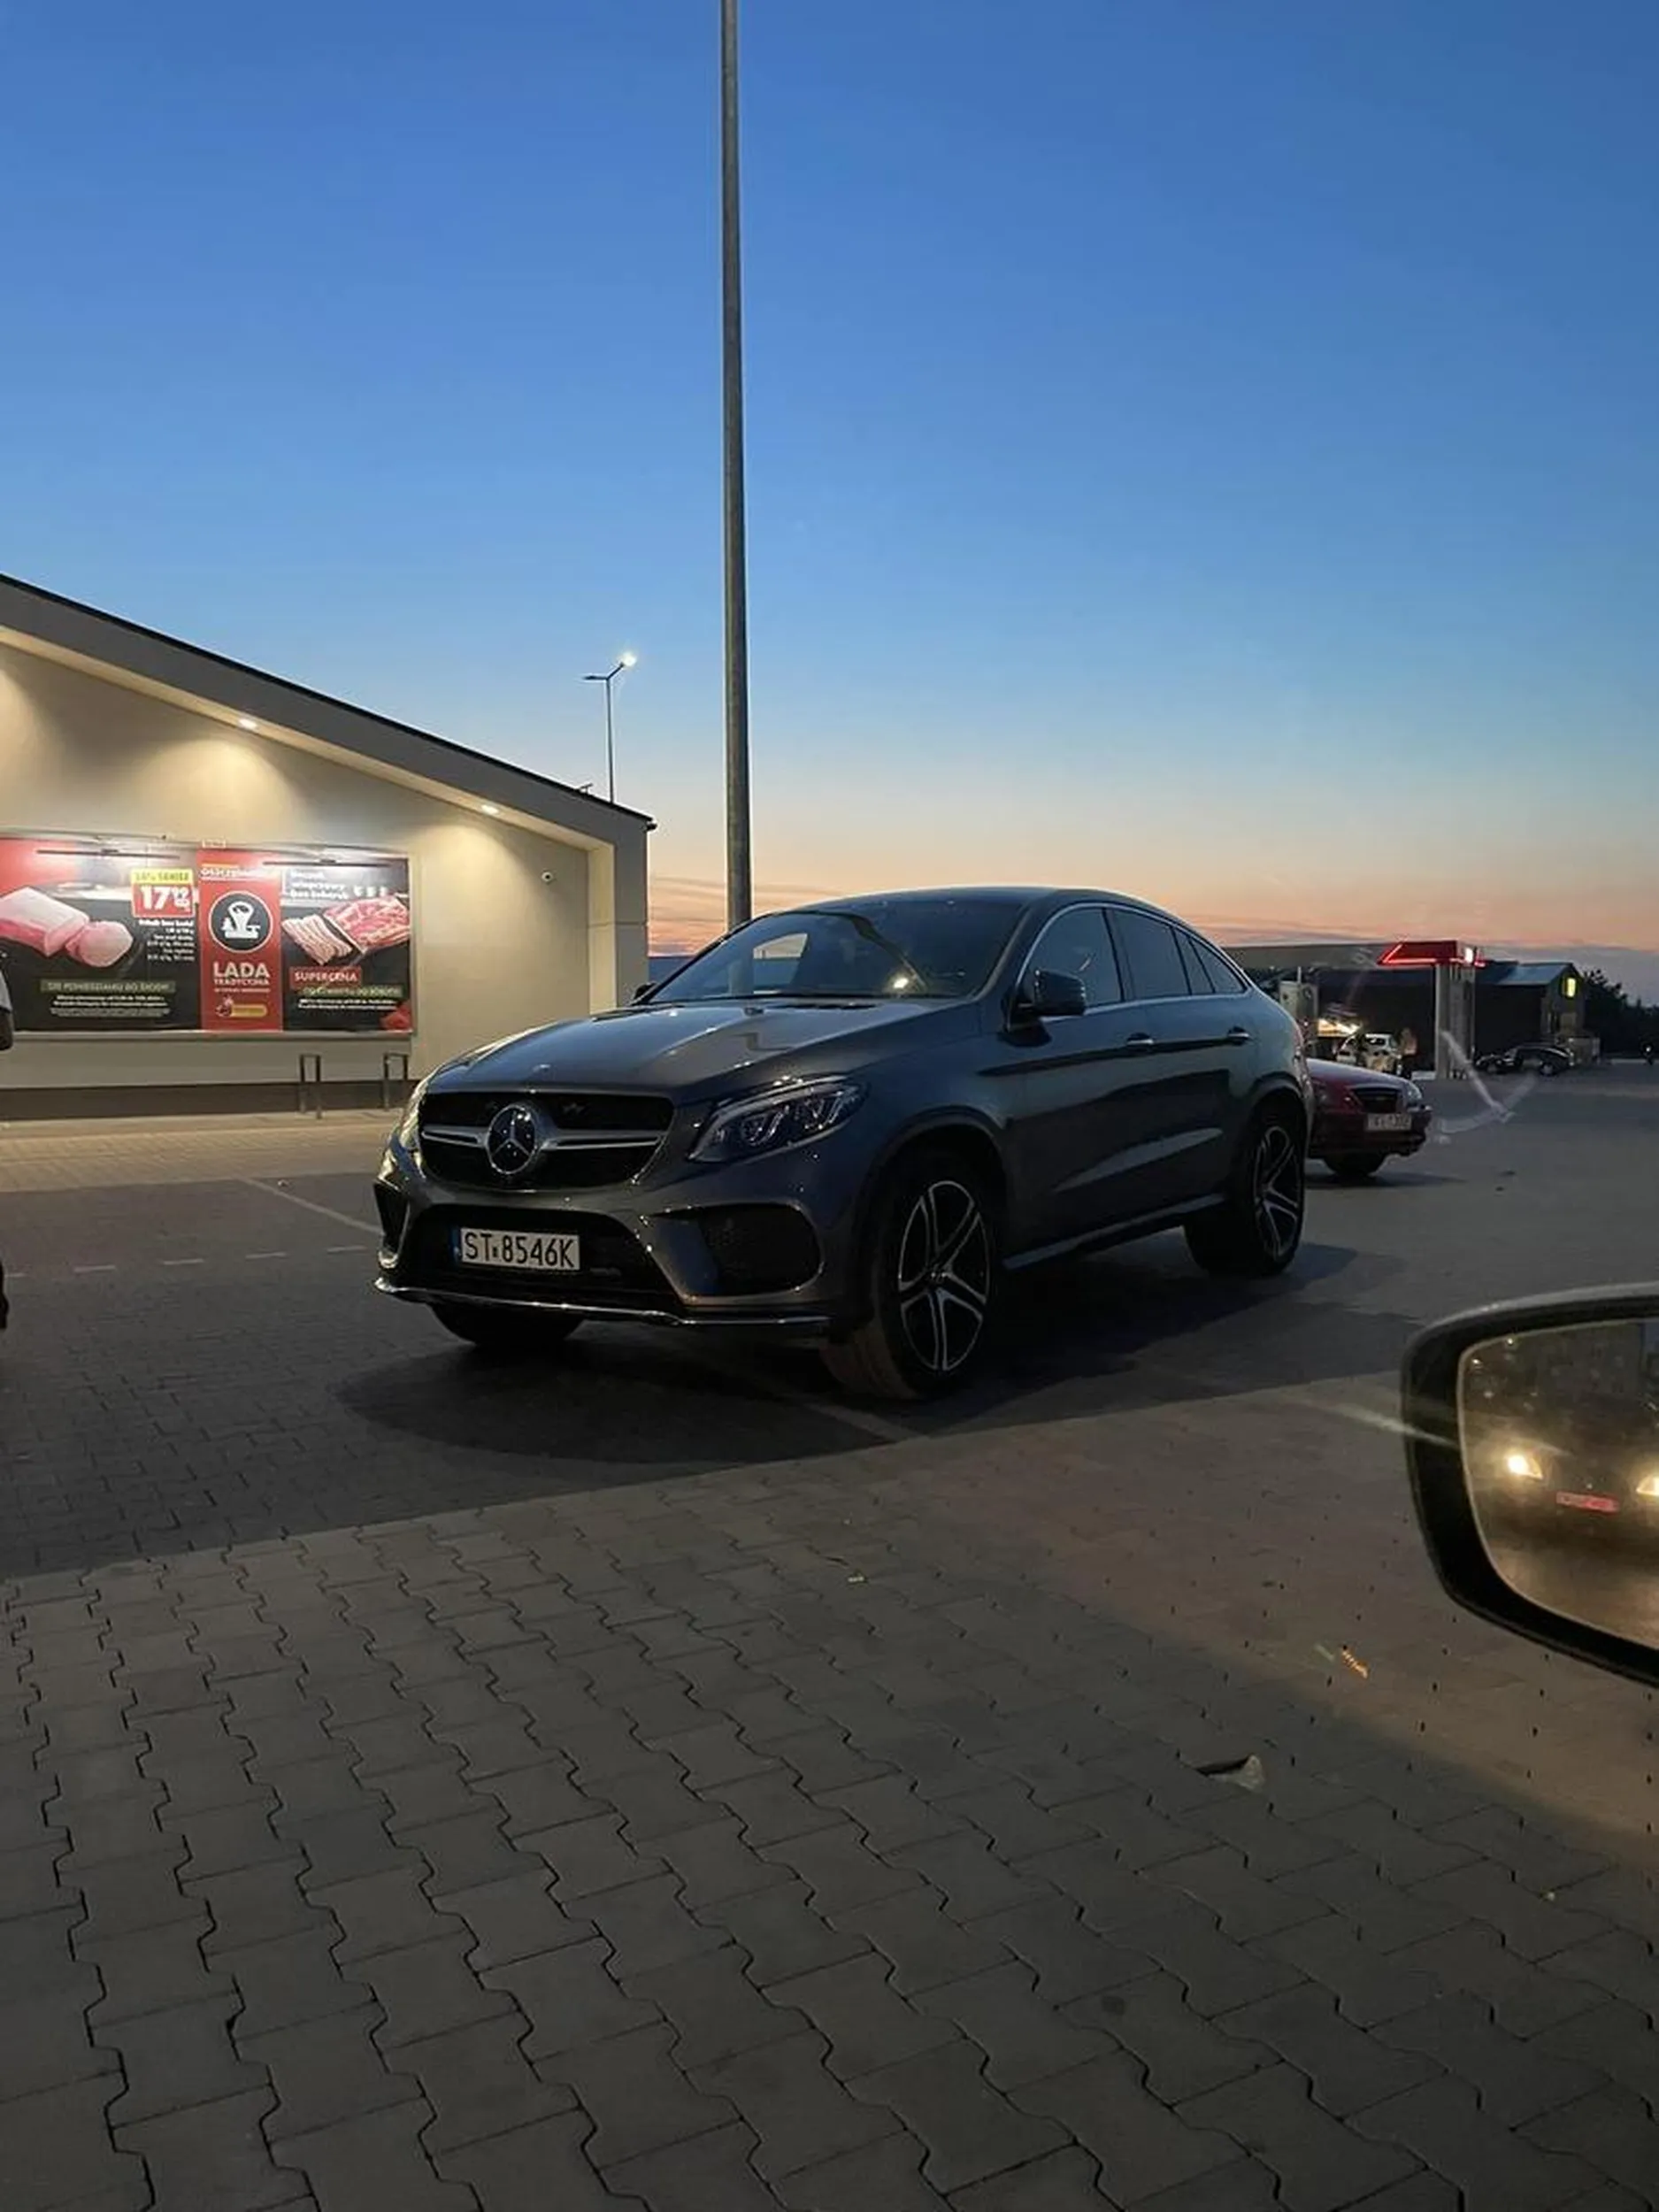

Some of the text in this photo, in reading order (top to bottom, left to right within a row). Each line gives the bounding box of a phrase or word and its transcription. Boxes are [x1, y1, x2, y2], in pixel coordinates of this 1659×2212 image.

[141, 885, 171, 910] 17
[213, 962, 271, 978] LADA
[294, 971, 357, 982] SUPERCENA
[465, 1233, 575, 1268] ST 8546K
